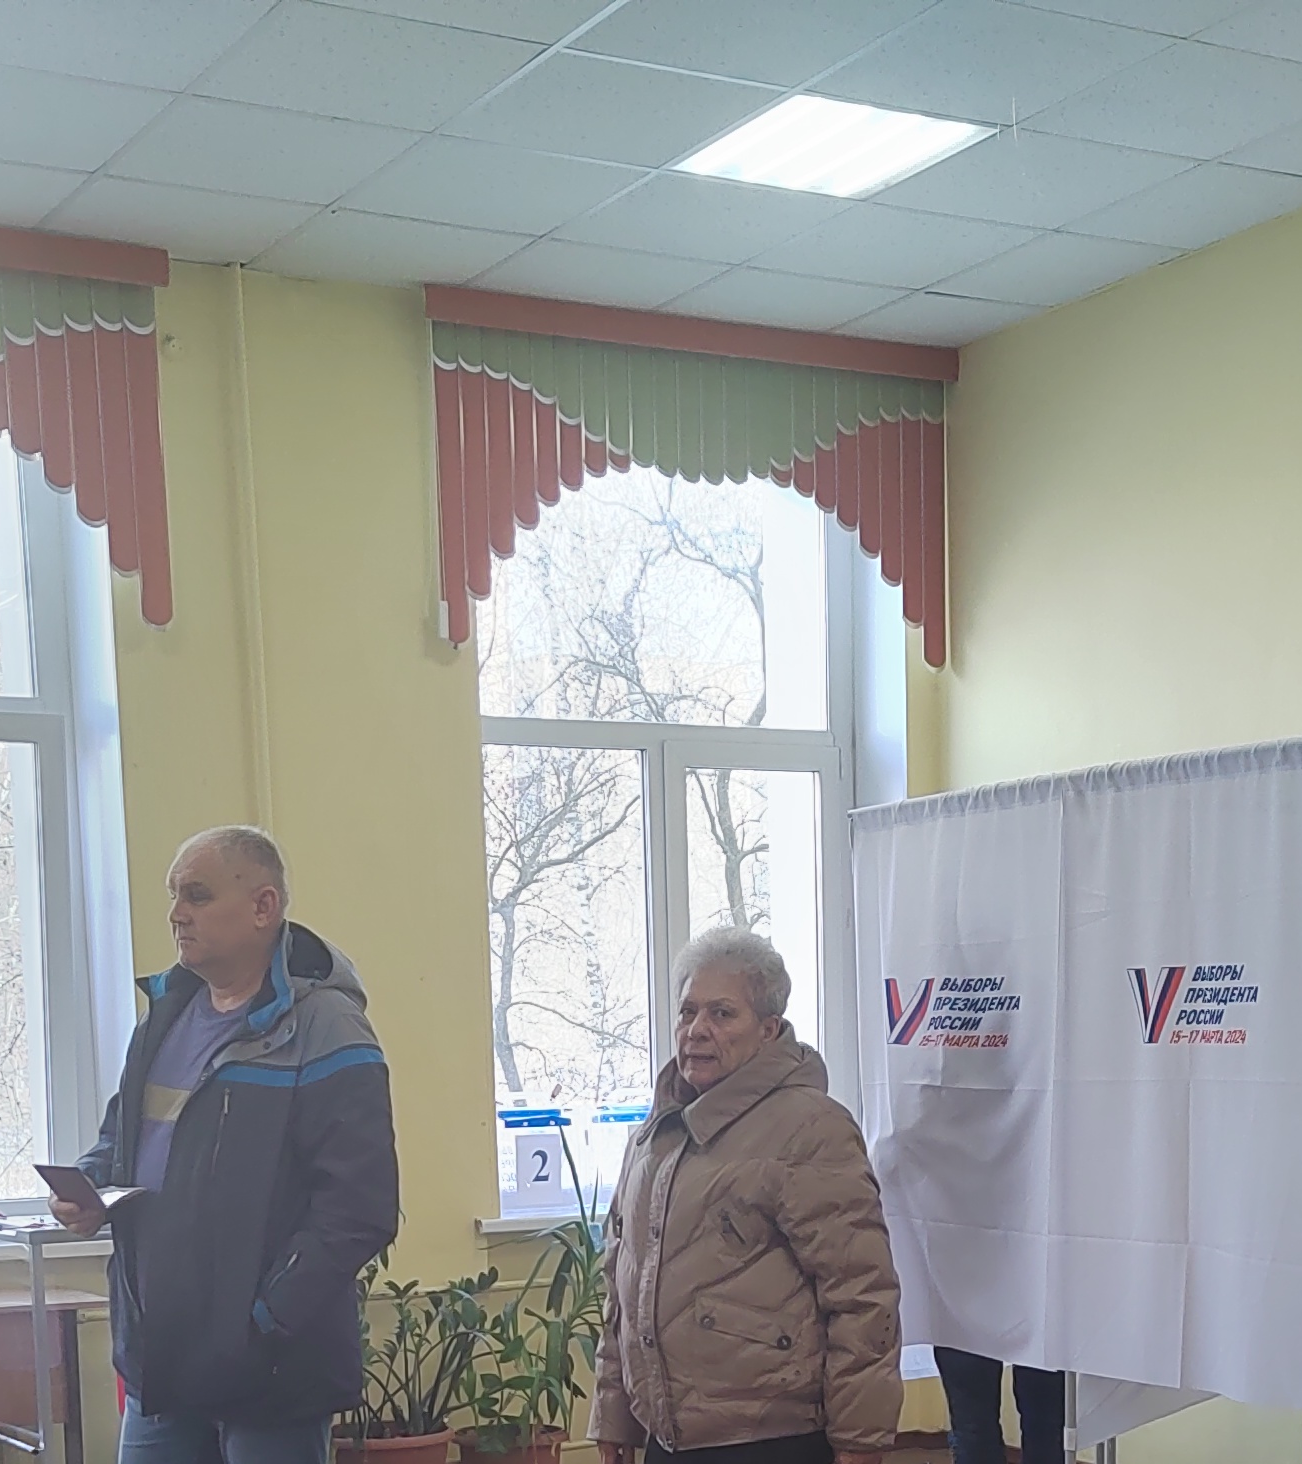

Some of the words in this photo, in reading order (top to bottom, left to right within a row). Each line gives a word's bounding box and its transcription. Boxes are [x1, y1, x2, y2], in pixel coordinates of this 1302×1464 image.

[1192, 964, 1245, 982] ВЫБОРЫ
[939, 977, 1005, 992] ВЫБОРЫ
[933, 996, 1021, 1013] ПРЕЗИДЕНТА
[1184, 986, 1259, 1006] ПРЕЗИДЕНТА
[927, 1016, 983, 1031] РОССИИ
[1175, 1009, 1225, 1026] РОССИИ
[942, 1033, 980, 1047] МАРТА
[980, 1034, 1009, 1047] 2024
[1199, 1029, 1224, 1044] МАРТА
[1224, 1029, 1247, 1044] 2024
[531, 1149, 550, 1182] 2
